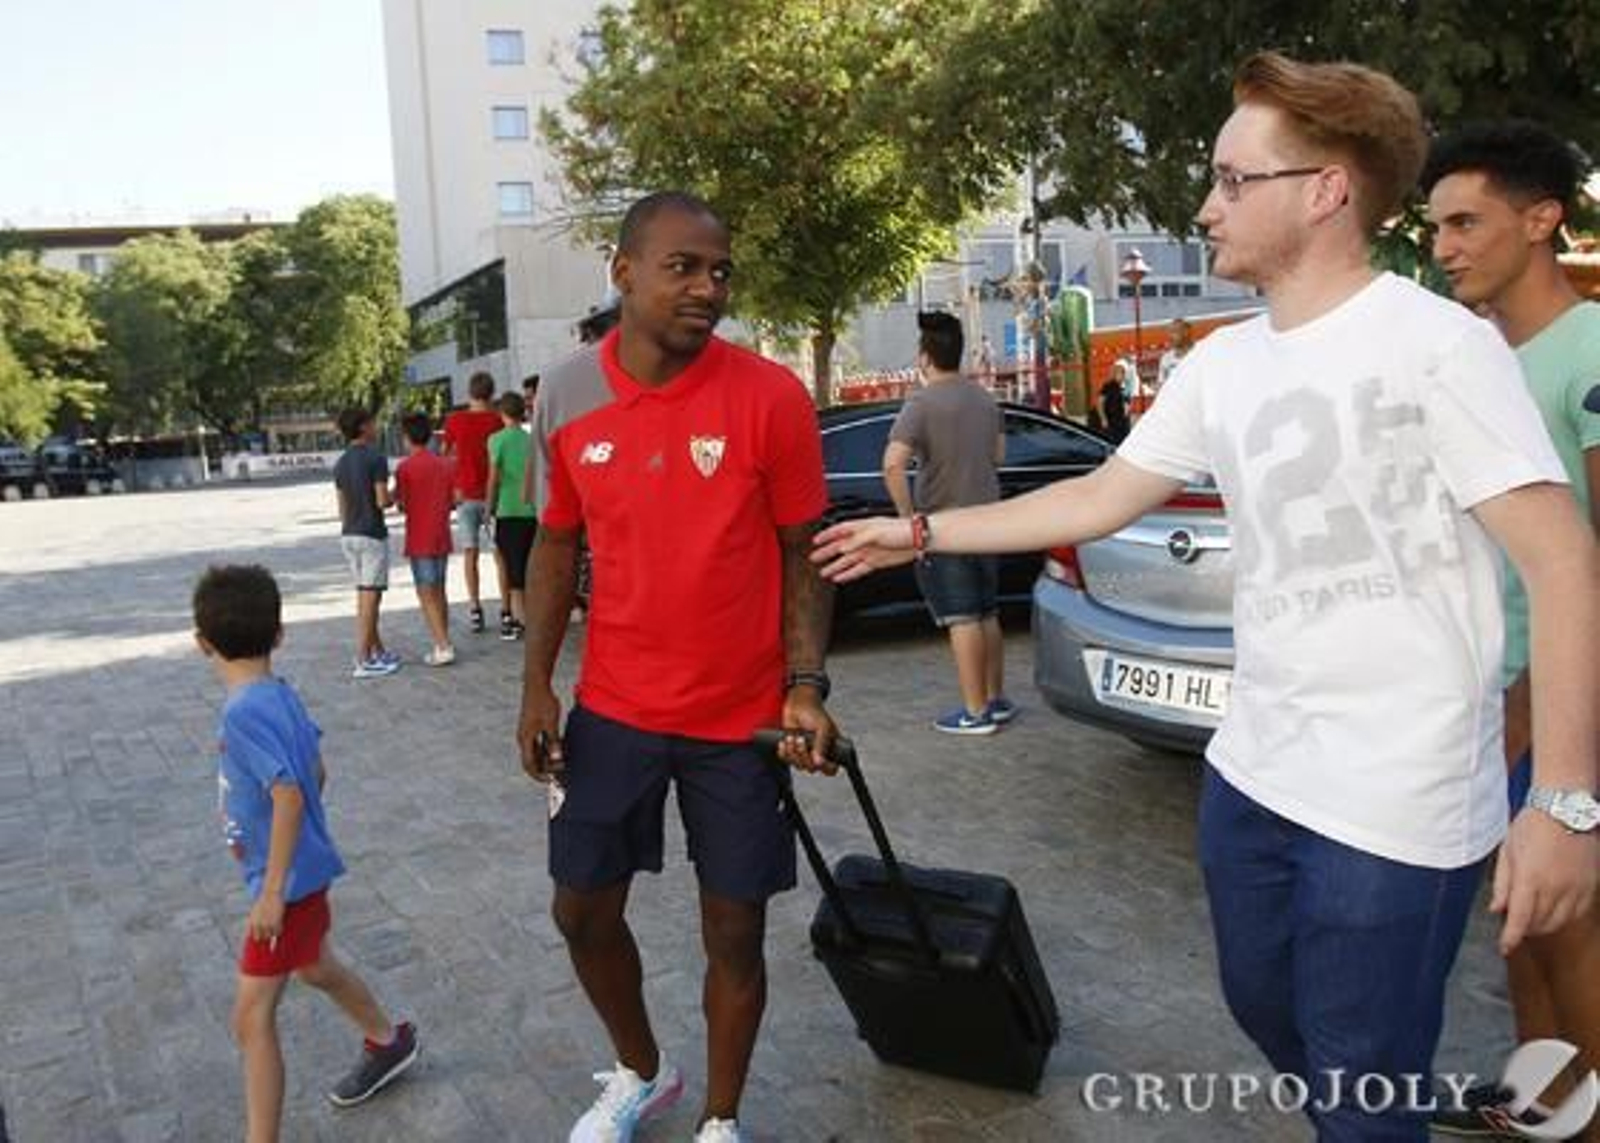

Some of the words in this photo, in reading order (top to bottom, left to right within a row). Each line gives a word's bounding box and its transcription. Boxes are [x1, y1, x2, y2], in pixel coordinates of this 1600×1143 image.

[1297, 573, 1396, 614] PARIS
[1115, 664, 1174, 700] 7991
[1185, 676, 1233, 709] HL
